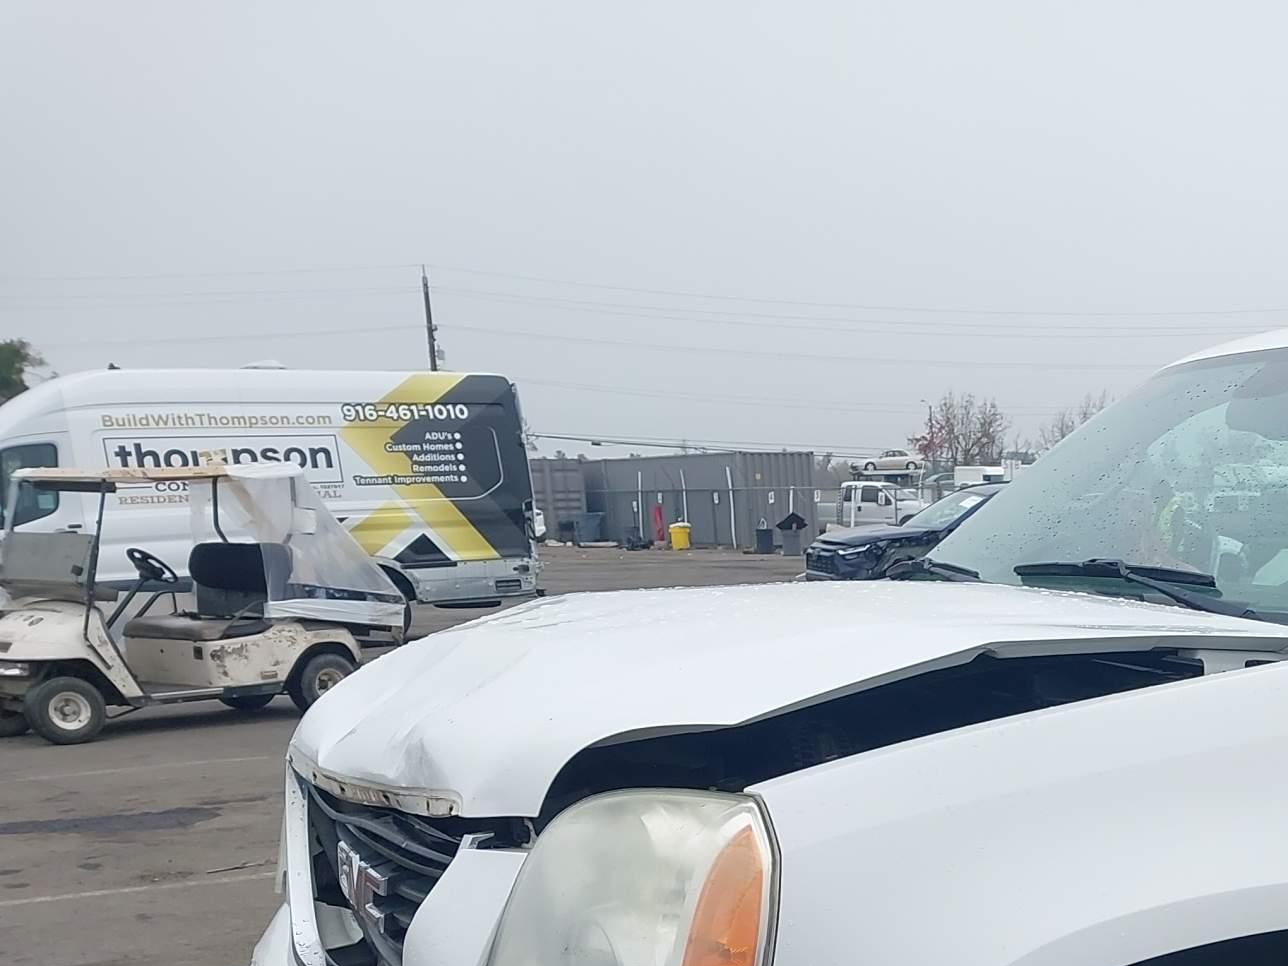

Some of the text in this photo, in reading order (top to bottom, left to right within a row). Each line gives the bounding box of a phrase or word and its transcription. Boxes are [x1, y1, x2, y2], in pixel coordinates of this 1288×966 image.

[342, 402, 469, 421] 916-461-1010
[101, 413, 332, 428] BuildWithThompson.com
[425, 432, 453, 440] ADU's
[385, 443, 455, 452] Custom Homes
[412, 453, 456, 461] Additions
[412, 464, 458, 472] Remodels
[354, 474, 459, 485] Tennant Improvements
